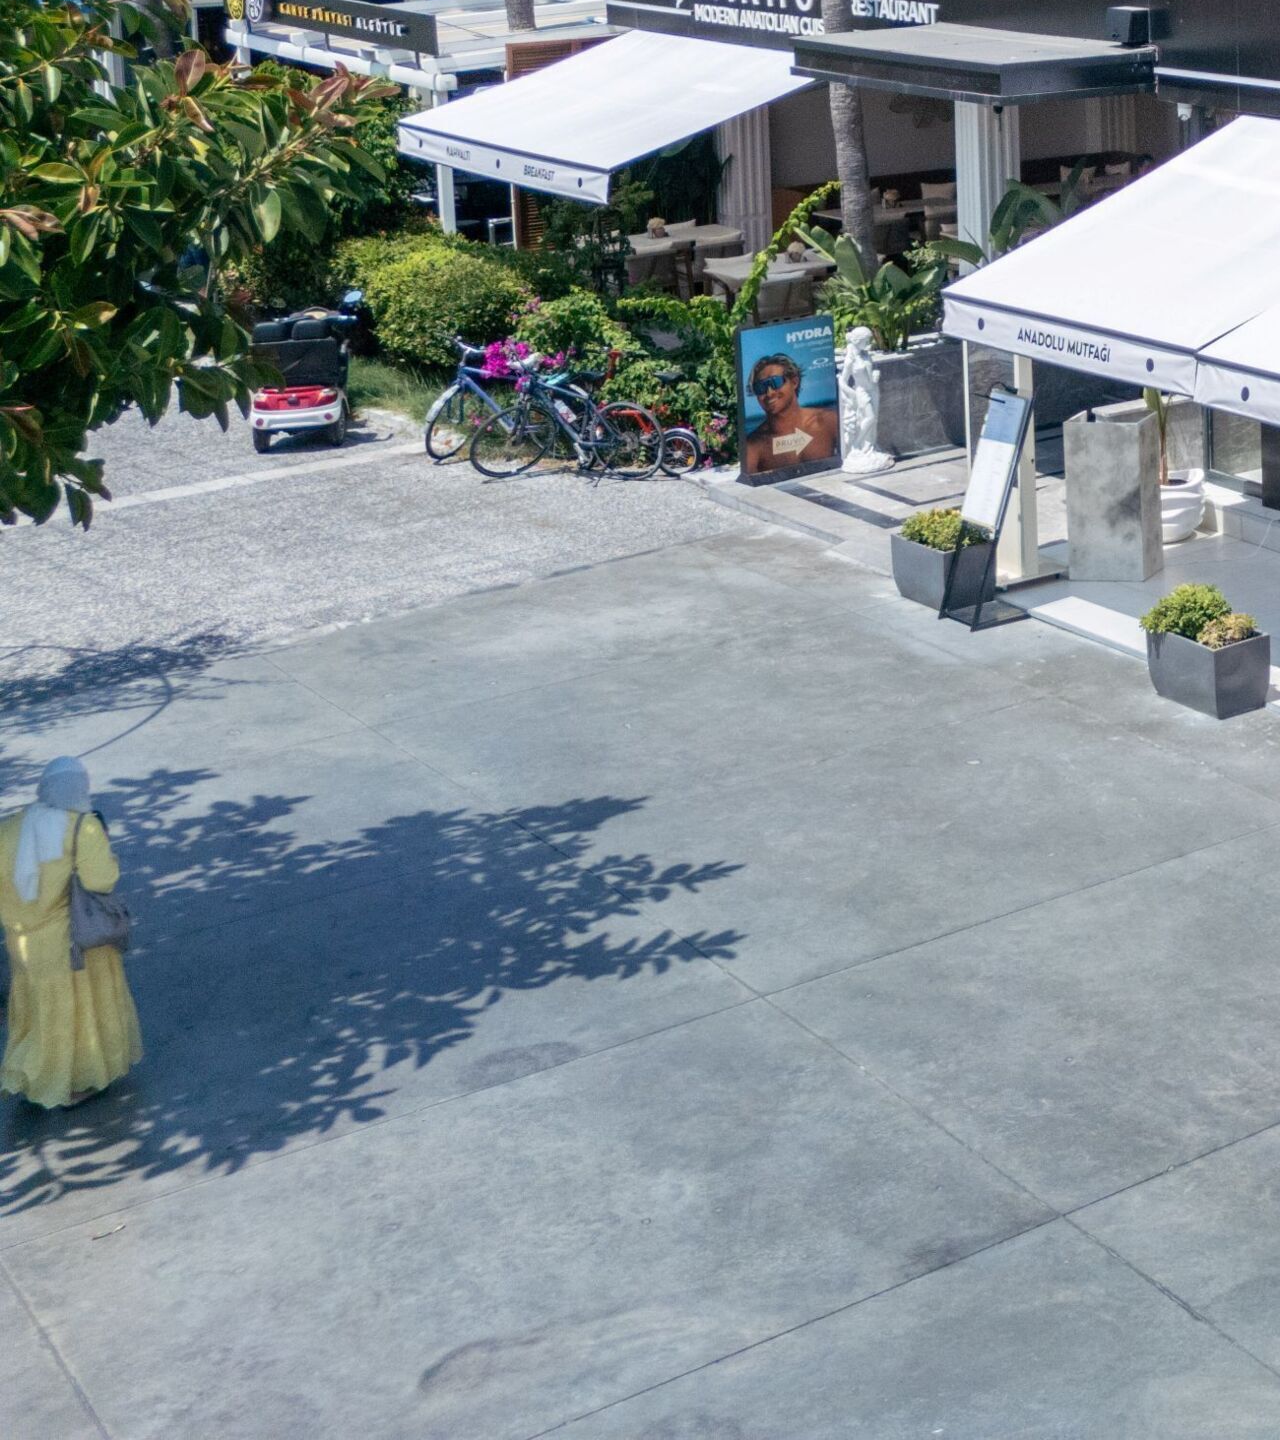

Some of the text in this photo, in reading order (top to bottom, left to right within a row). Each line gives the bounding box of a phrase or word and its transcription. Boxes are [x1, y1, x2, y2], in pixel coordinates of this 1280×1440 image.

[694, 3, 825, 36] MODERN ANATOLIAN CUIS
[523, 165, 555, 181] BREAKFAST
[787, 326, 832, 343] HYDRA
[1017, 328, 1111, 363] ANADOLU MUTFAĞI
